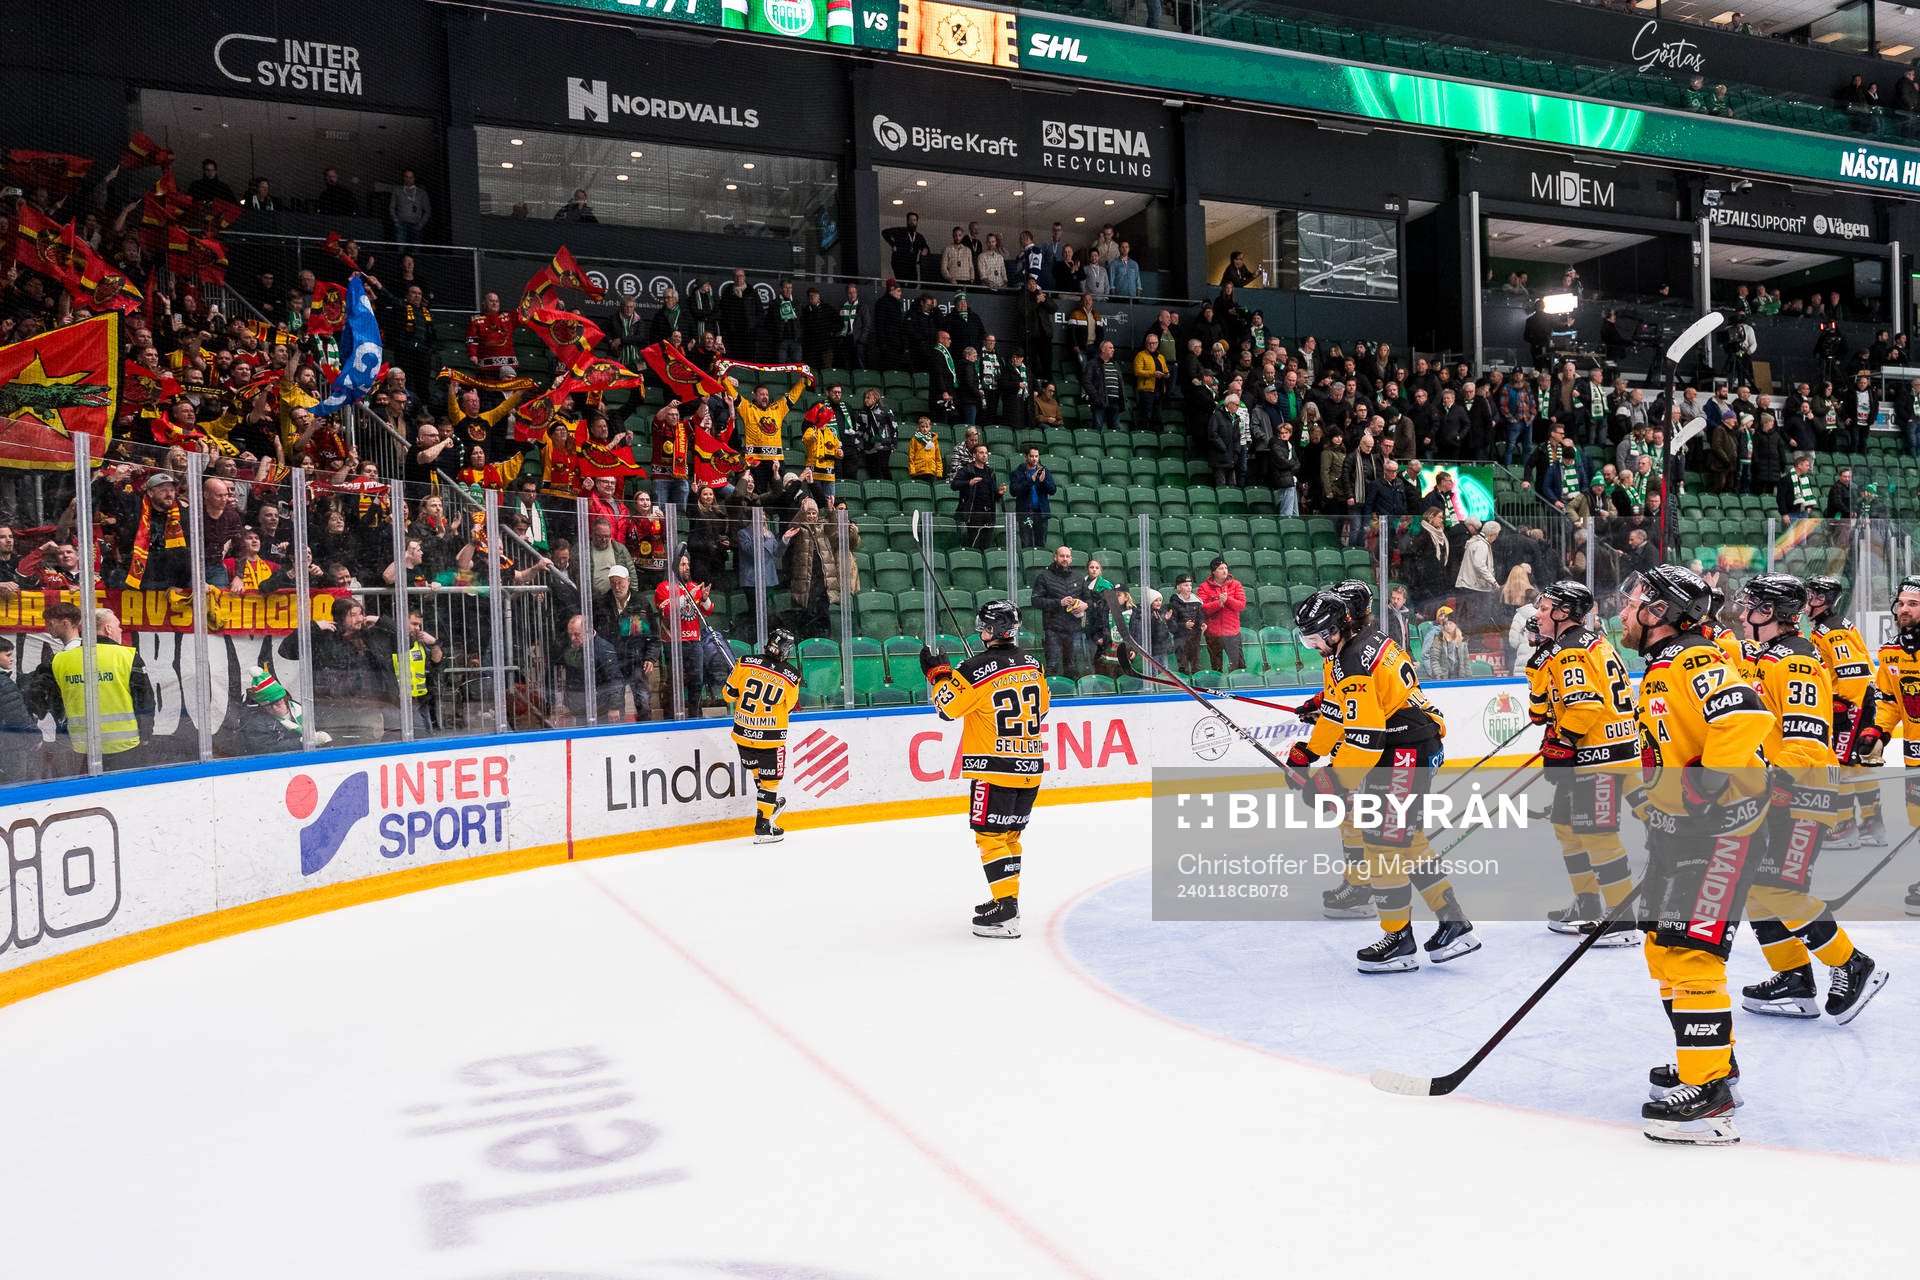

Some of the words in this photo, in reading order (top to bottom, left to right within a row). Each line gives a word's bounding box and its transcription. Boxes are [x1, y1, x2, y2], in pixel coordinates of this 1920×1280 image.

[863, 11, 889, 31] VS
[284, 38, 361, 71] INTER
[1029, 33, 1088, 63] SHL
[1631, 20, 1706, 73] Göstas
[257, 60, 363, 96] SYSTEM
[611, 93, 760, 128] NORDVALLS
[912, 126, 964, 152] Bjäre
[966, 133, 1018, 158] Kraft
[1068, 123, 1151, 158] STENA
[1043, 151, 1152, 178] RECYCLING
[1840, 147, 1899, 184] NÄSTA
[1531, 170, 1615, 208] MIDEM
[1708, 207, 1803, 233] RETAILSUPPORT
[1826, 217, 1870, 240] Vågen
[744, 656, 763, 666] SSAB
[1834, 644, 1851, 661] 14
[973, 660, 999, 682] SSAB
[1562, 667, 1586, 689] 29
[1692, 666, 1727, 701] 67
[741, 677, 784, 714] 24
[1787, 680, 1818, 707] 38
[992, 683, 1042, 738] 23
[1345, 698, 1358, 721] 3
[743, 728, 764, 740] SSAB
[1657, 719, 1672, 743] A
[1790, 720, 1824, 736] LKAB
[963, 758, 989, 770] SSAB
[1014, 760, 1040, 773] SSAB
[1576, 748, 1611, 763] SSAB
[380, 755, 510, 809] INTER
[379, 800, 512, 859] SPORT
[1690, 838, 1741, 938] NÅIDEN
[1684, 1022, 1722, 1036] NEX
